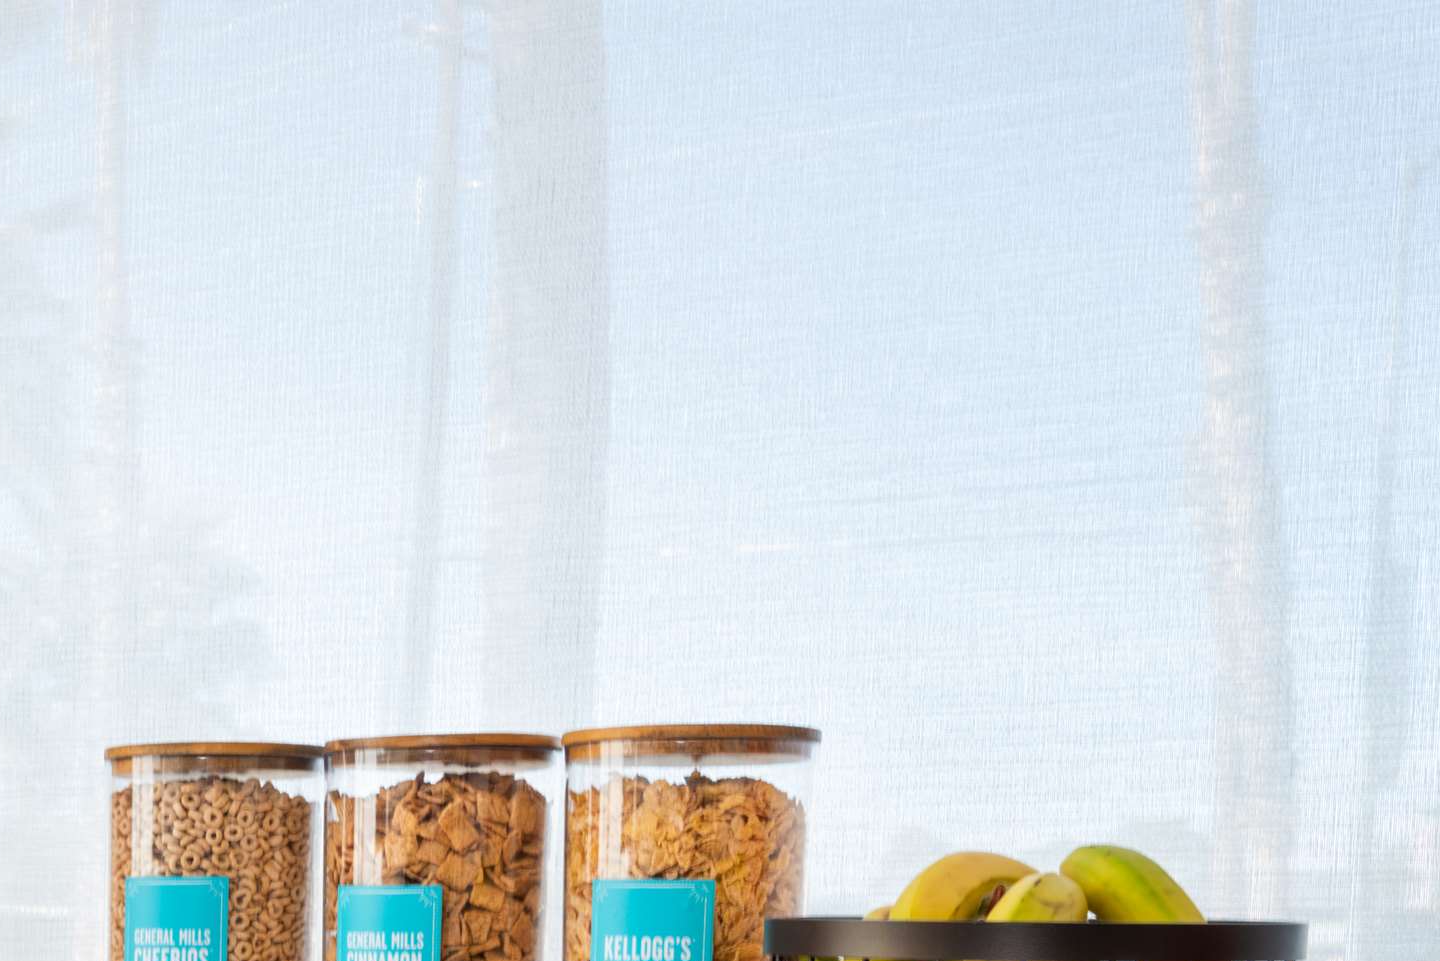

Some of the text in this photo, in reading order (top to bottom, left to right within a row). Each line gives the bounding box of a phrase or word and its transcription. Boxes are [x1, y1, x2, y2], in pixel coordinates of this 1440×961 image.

[134, 927, 211, 946] GENERAL MILLS
[346, 930, 424, 950] GENERAL MILLS
